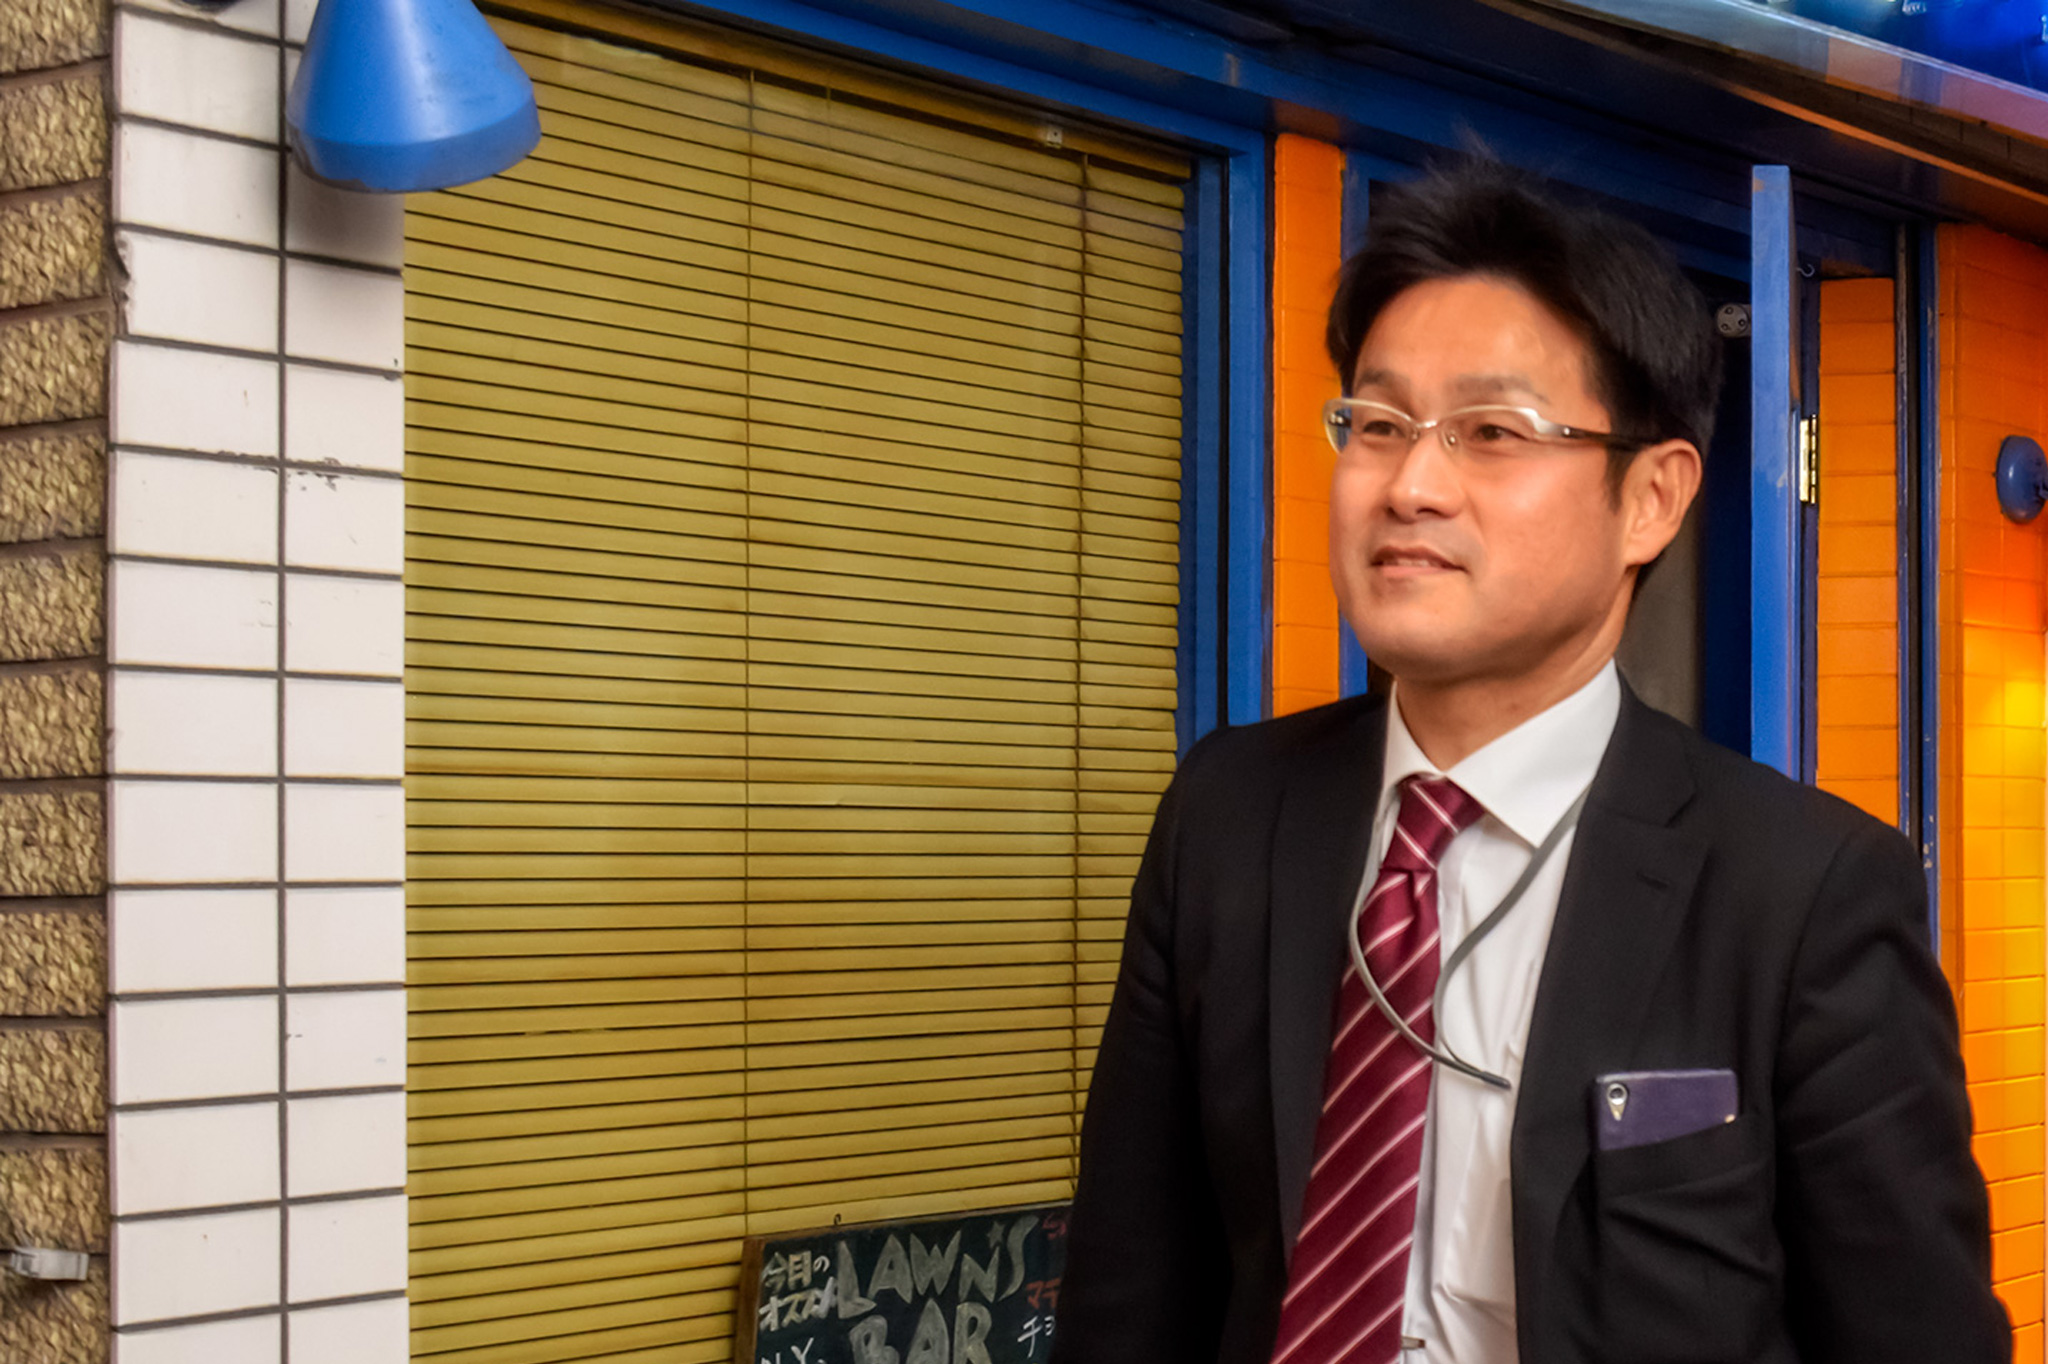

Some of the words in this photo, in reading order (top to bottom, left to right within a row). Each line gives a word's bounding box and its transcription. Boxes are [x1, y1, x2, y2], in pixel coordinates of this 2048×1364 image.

[761, 1250, 831, 1294] 今月の
[848, 1298, 993, 1364] BAR
